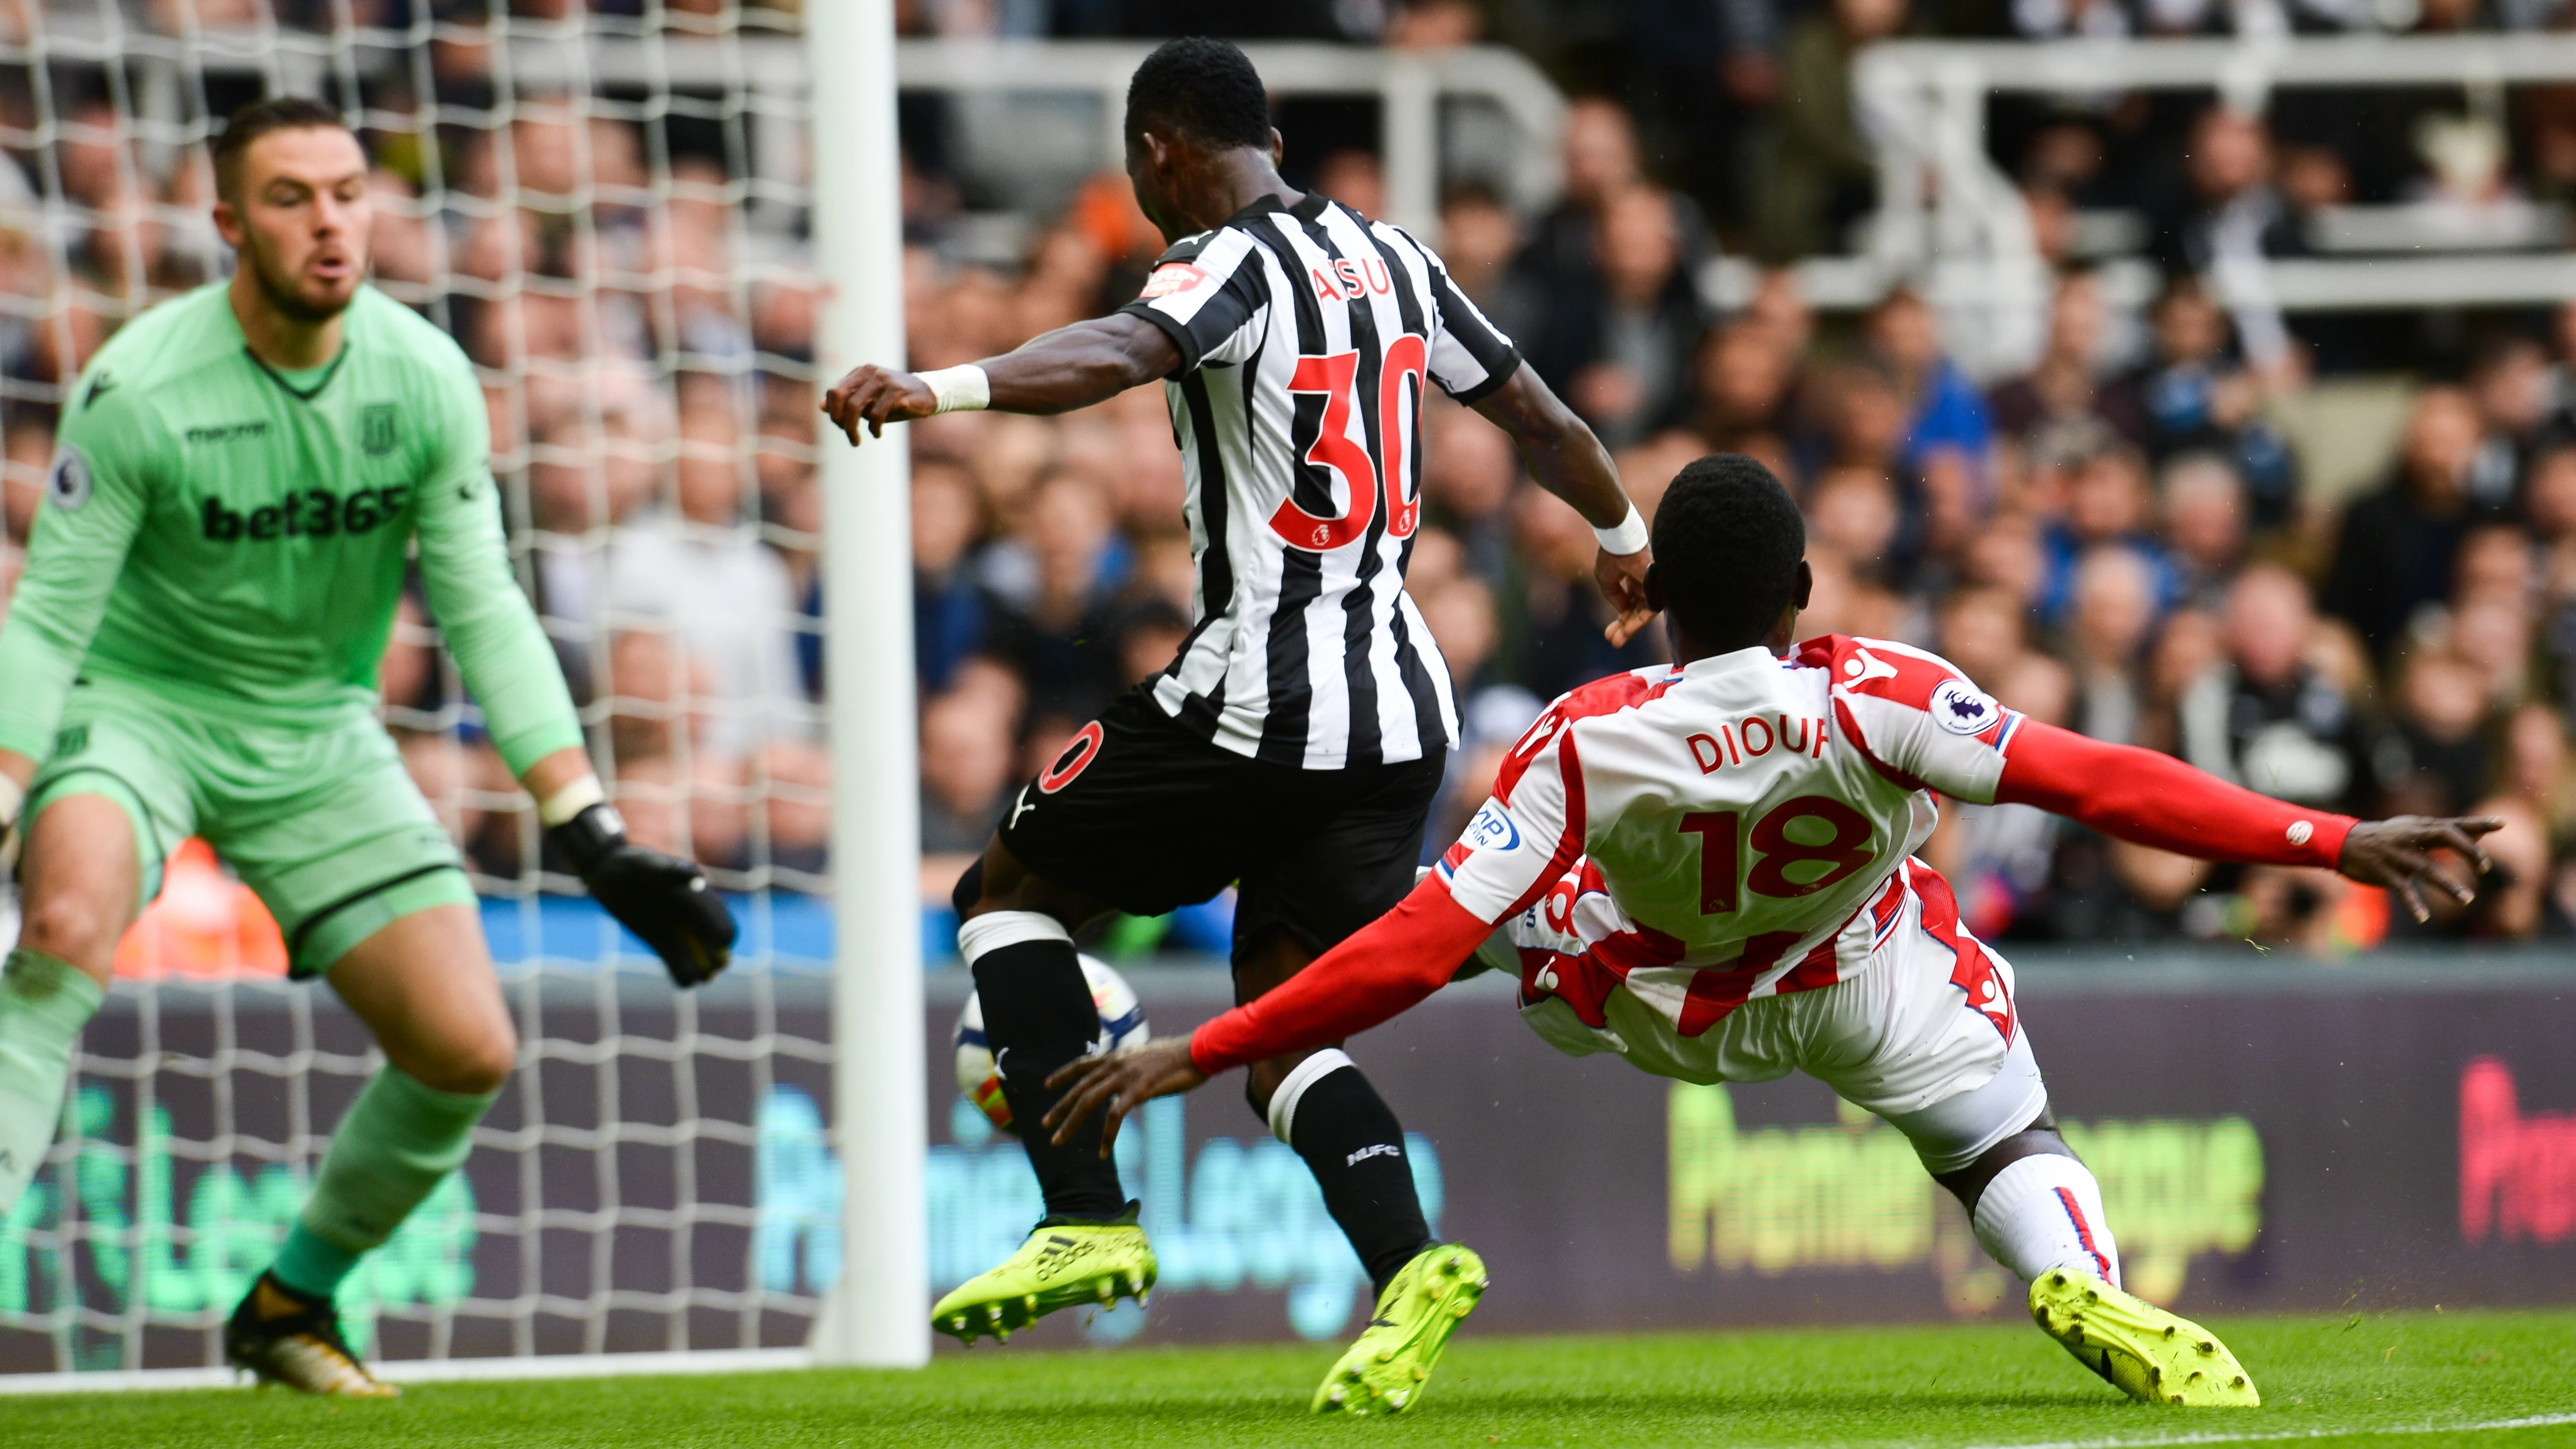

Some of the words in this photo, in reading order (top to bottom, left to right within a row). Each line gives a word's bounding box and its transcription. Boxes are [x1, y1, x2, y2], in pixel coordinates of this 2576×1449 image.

[1312, 257, 1390, 310] ASU
[1268, 332, 1426, 553] 30
[202, 483, 410, 543] bet365
[1678, 795, 1876, 917] 18
[1347, 1143, 1401, 1167] NUFC
